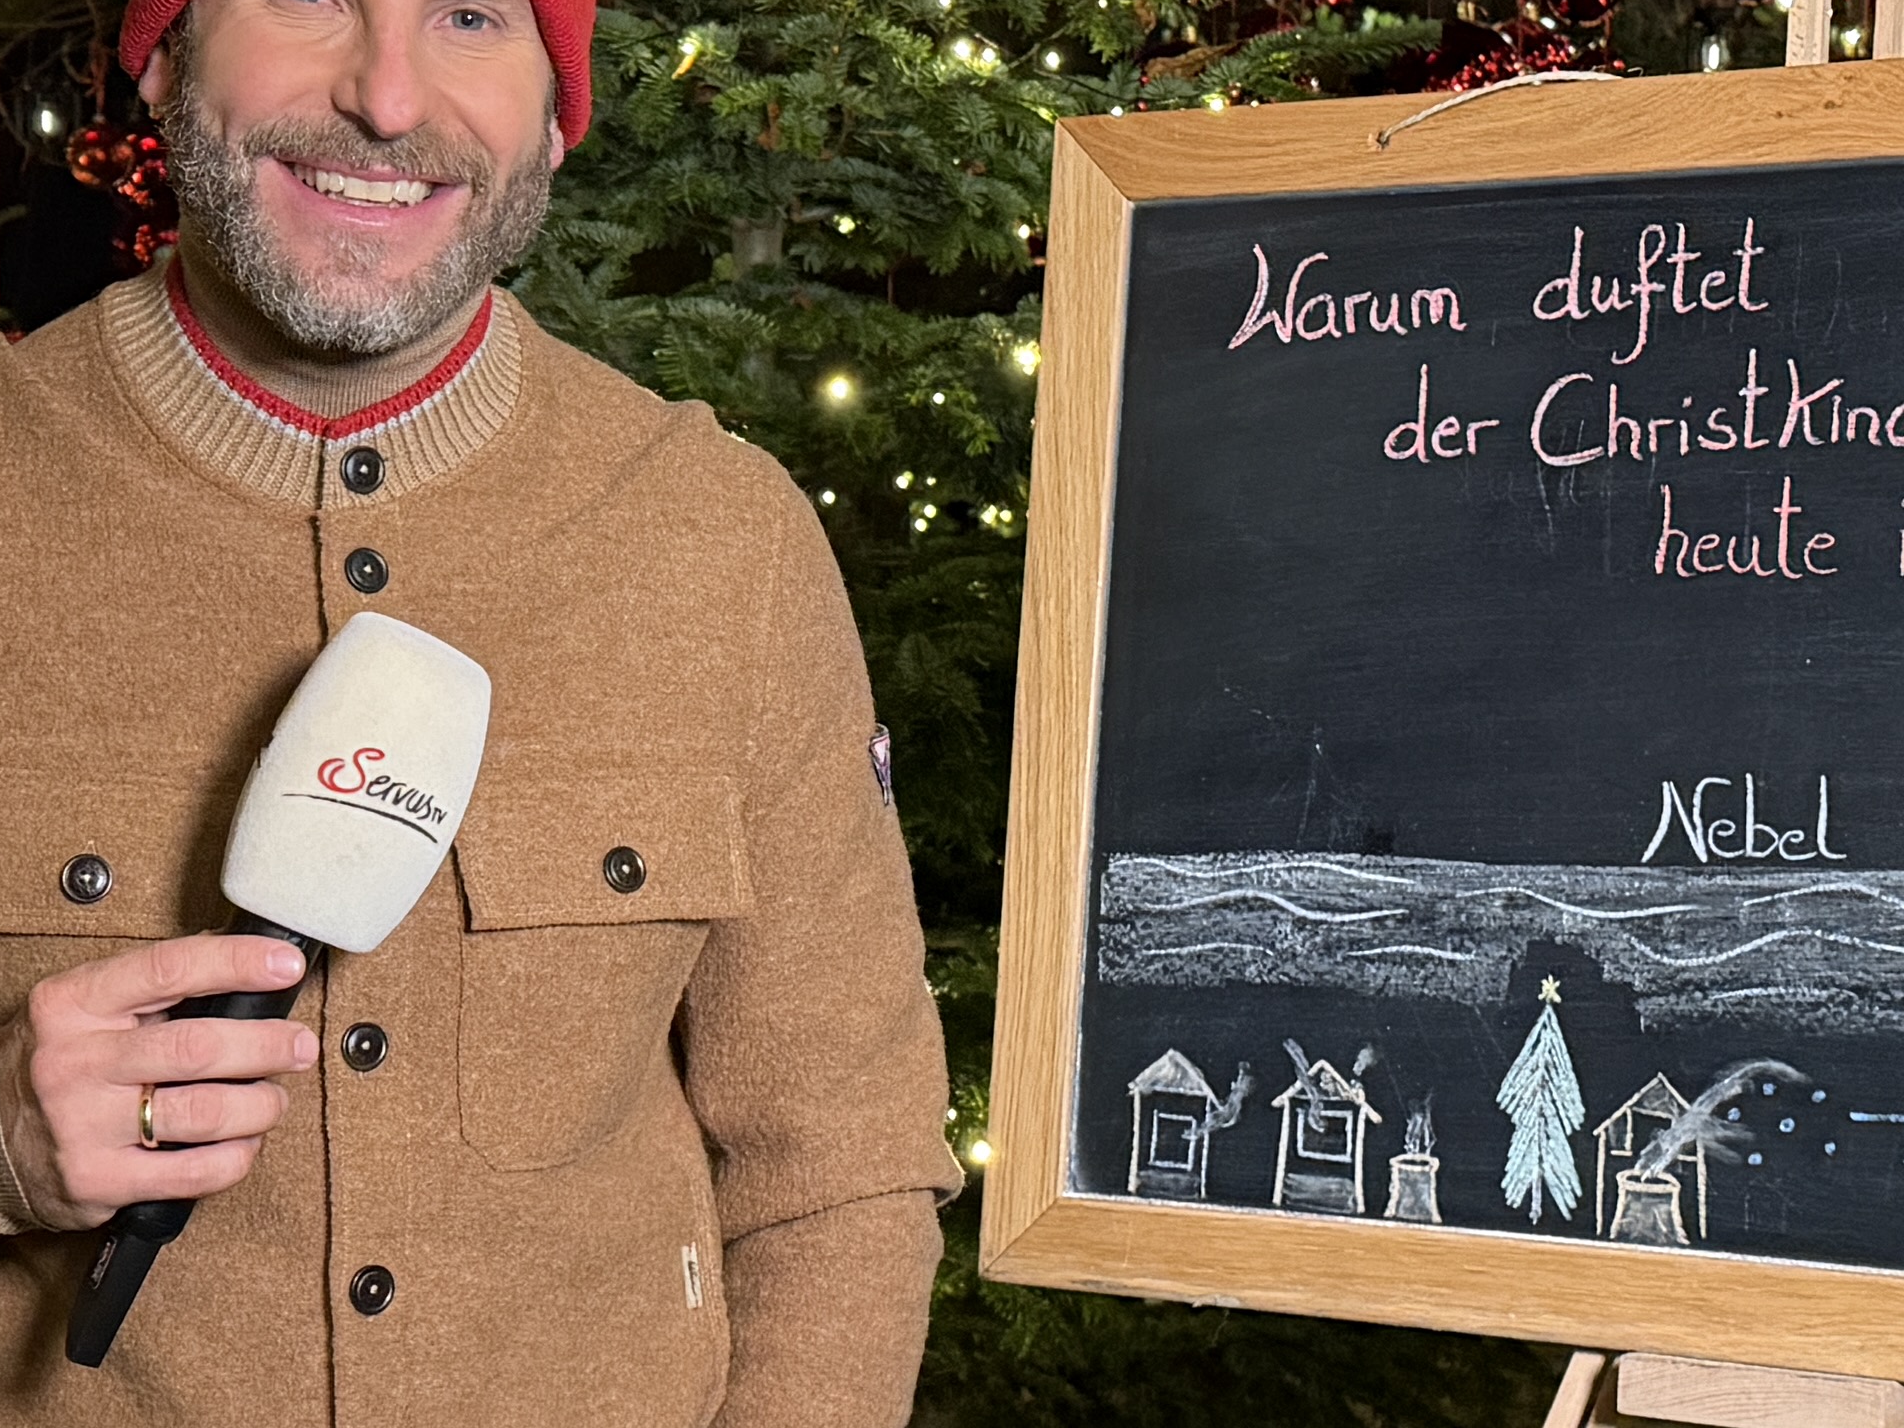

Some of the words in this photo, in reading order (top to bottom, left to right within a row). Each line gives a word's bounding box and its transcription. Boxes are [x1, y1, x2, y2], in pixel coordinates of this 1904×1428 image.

[1227, 243, 1467, 350] Warum
[1532, 216, 1770, 364] duftet
[1383, 363, 1500, 463] der
[1654, 475, 1838, 579] heute
[1640, 772, 1848, 864] Nebel
